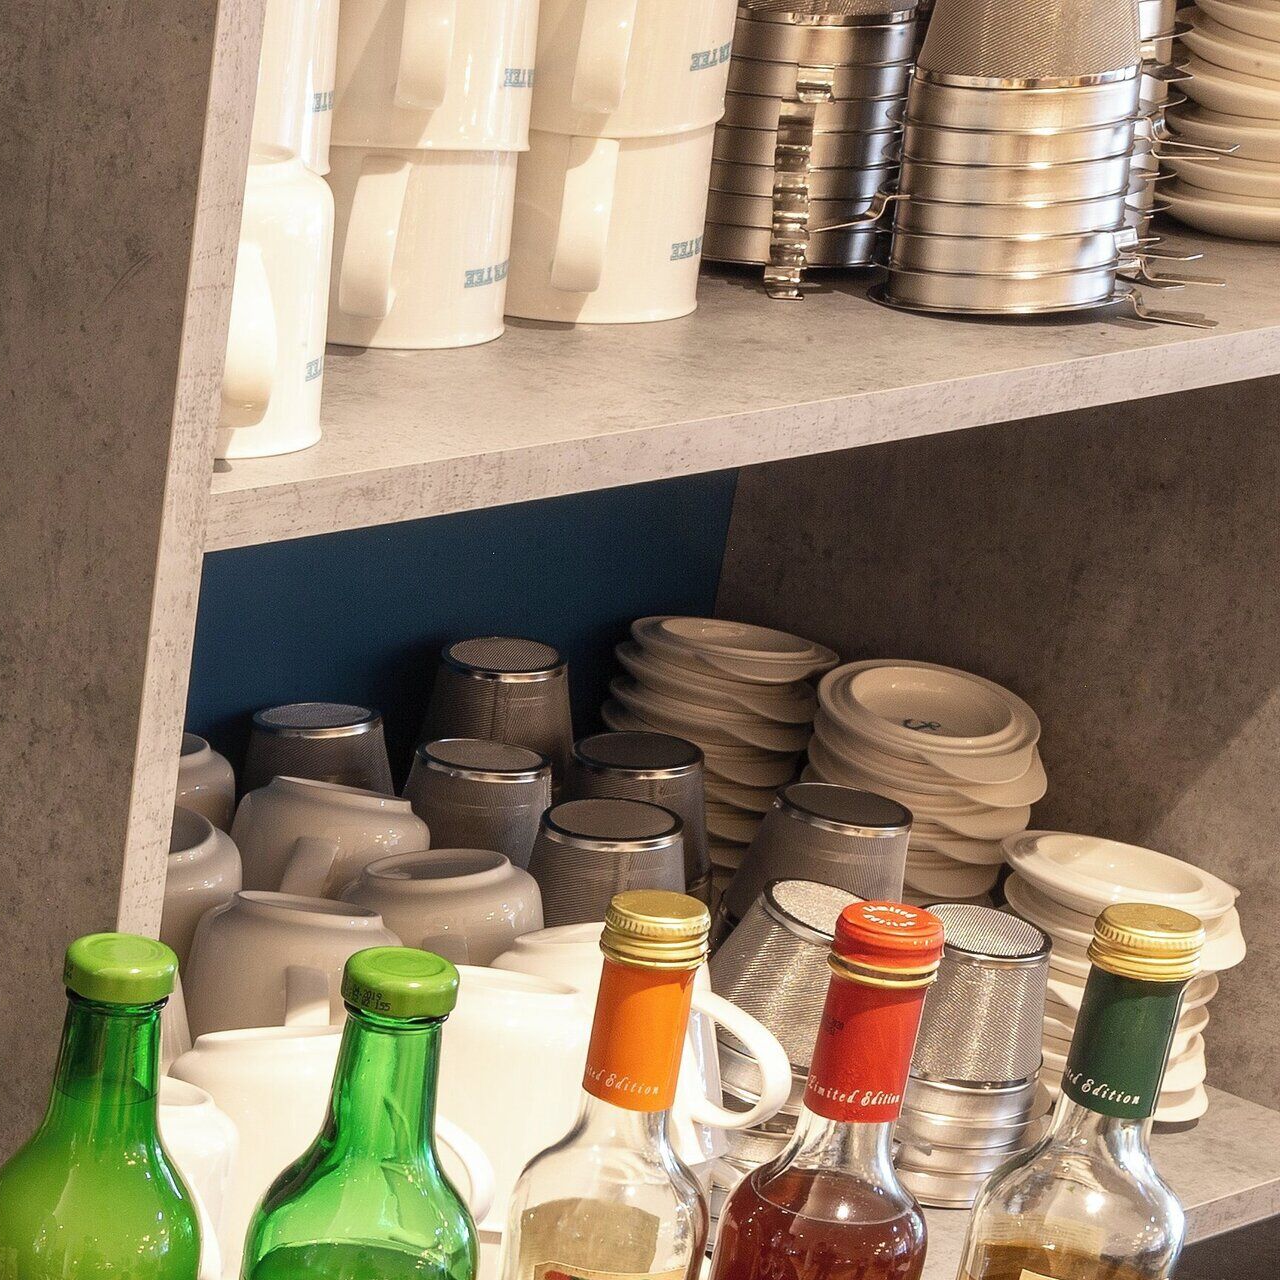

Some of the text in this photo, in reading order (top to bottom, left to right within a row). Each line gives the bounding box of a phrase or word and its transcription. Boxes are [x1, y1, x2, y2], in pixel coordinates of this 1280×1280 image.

[605, 1073, 660, 1096] Edition
[807, 1074, 860, 1104] Limited
[1081, 1078, 1140, 1105] Edition
